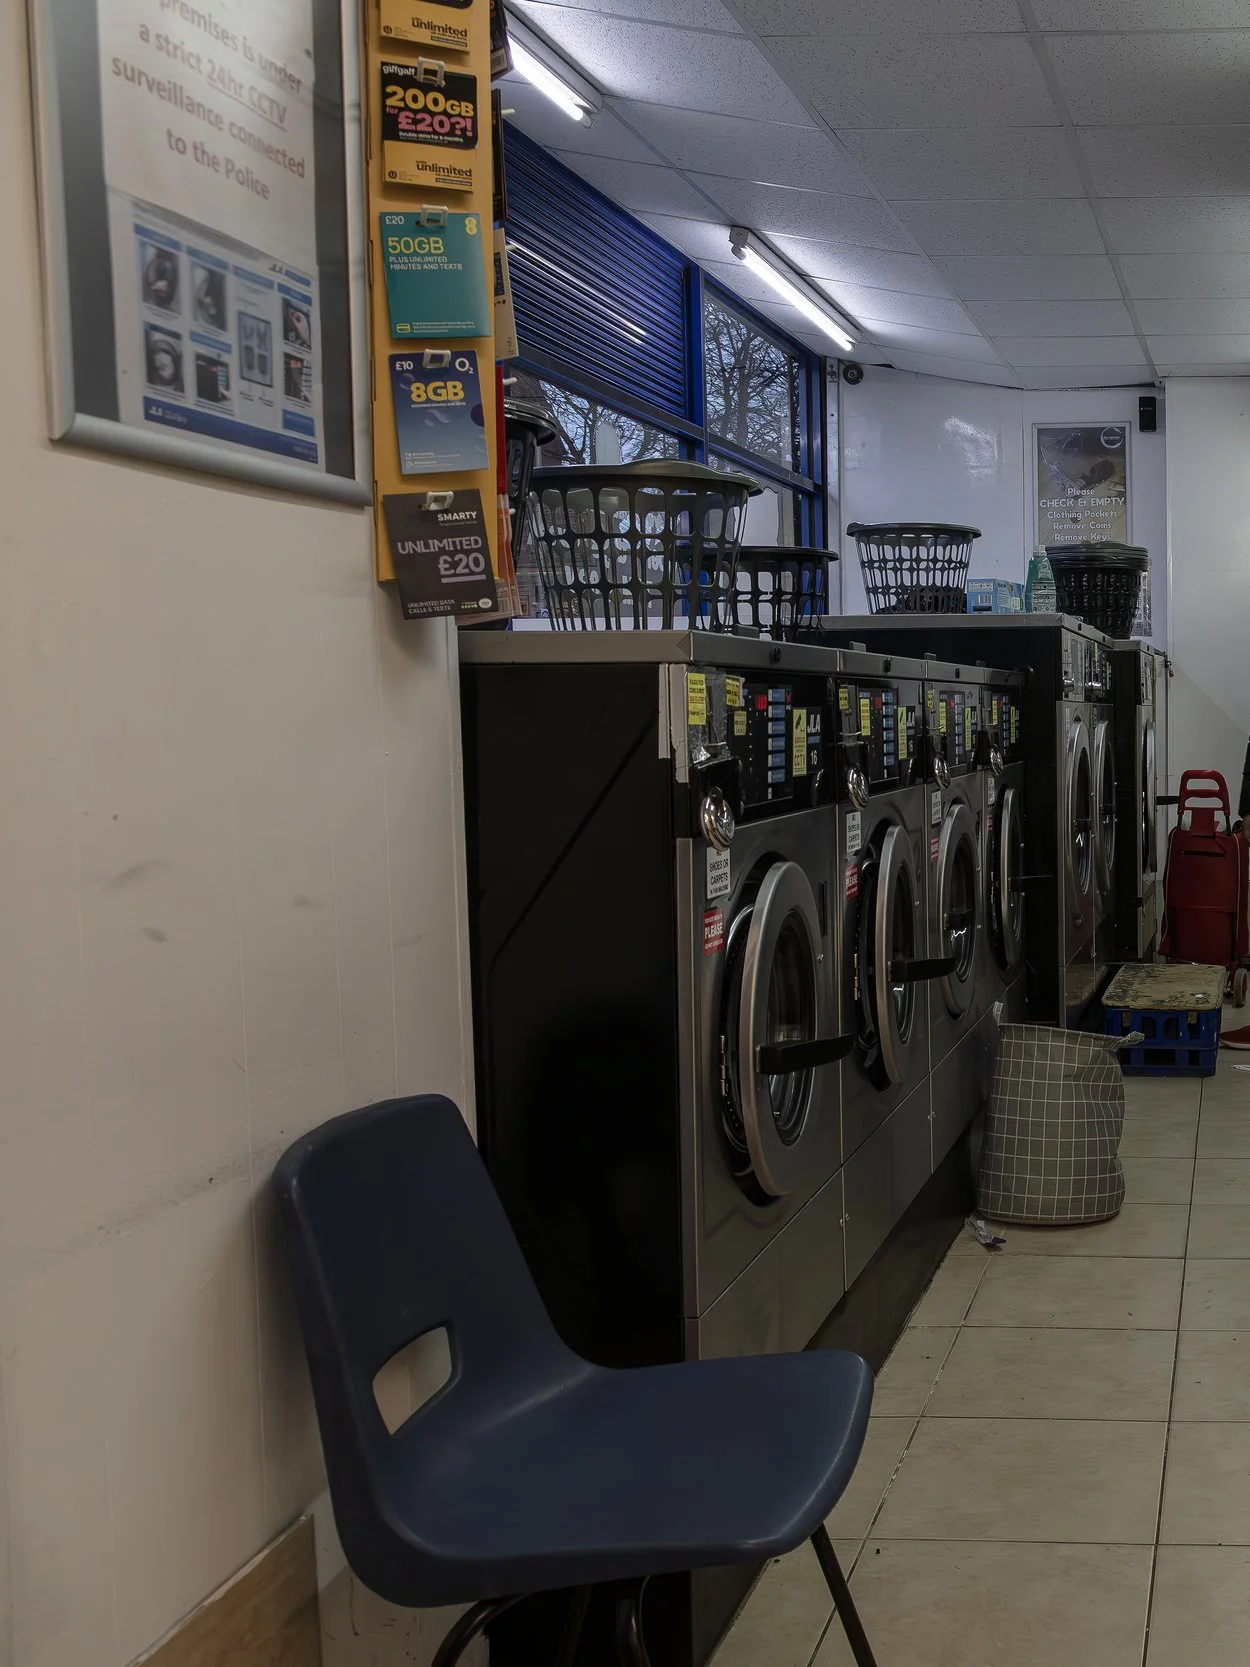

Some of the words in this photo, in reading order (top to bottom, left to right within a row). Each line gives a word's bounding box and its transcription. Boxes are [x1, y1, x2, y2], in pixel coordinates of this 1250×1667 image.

[411, 18, 468, 37] unlimited
[159, 0, 238, 51] premises
[243, 36, 255, 62] is
[258, 53, 301, 93] under
[139, 23, 149, 43] a
[154, 32, 203, 74] strict
[207, 58, 245, 98] 24hr
[248, 86, 288, 124] CCTV
[384, 84, 475, 118] 200GB
[111, 57, 224, 131] surveillance
[228, 121, 305, 178] connected
[398, 110, 473, 137] £20?!
[166, 128, 187, 155] to
[192, 141, 221, 173] the
[224, 155, 271, 200] Police
[416, 163, 472, 178] unlimited
[385, 215, 405, 225] £20
[387, 237, 445, 254] 50GB
[390, 263, 421, 271] MINUTES
[395, 361, 414, 371] £10
[410, 381, 465, 402] 8GB
[1067, 487, 1096, 496] Please
[1040, 498, 1074, 508] CHECK
[1091, 497, 1125, 506] EMPTY
[437, 511, 477, 522] SMARTY
[1047, 511, 1082, 520] Clothing
[1085, 510, 1118, 518] Pockets
[397, 536, 482, 555] UNLIMITED
[1054, 533, 1087, 541] Remove
[1090, 533, 1111, 541] Keys
[438, 552, 485, 576] £20
[807, 714, 820, 733] JLA
[709, 860, 722, 872] SHOES
[710, 872, 728, 885] CARPETS
[704, 922, 723, 939] PLEASE
